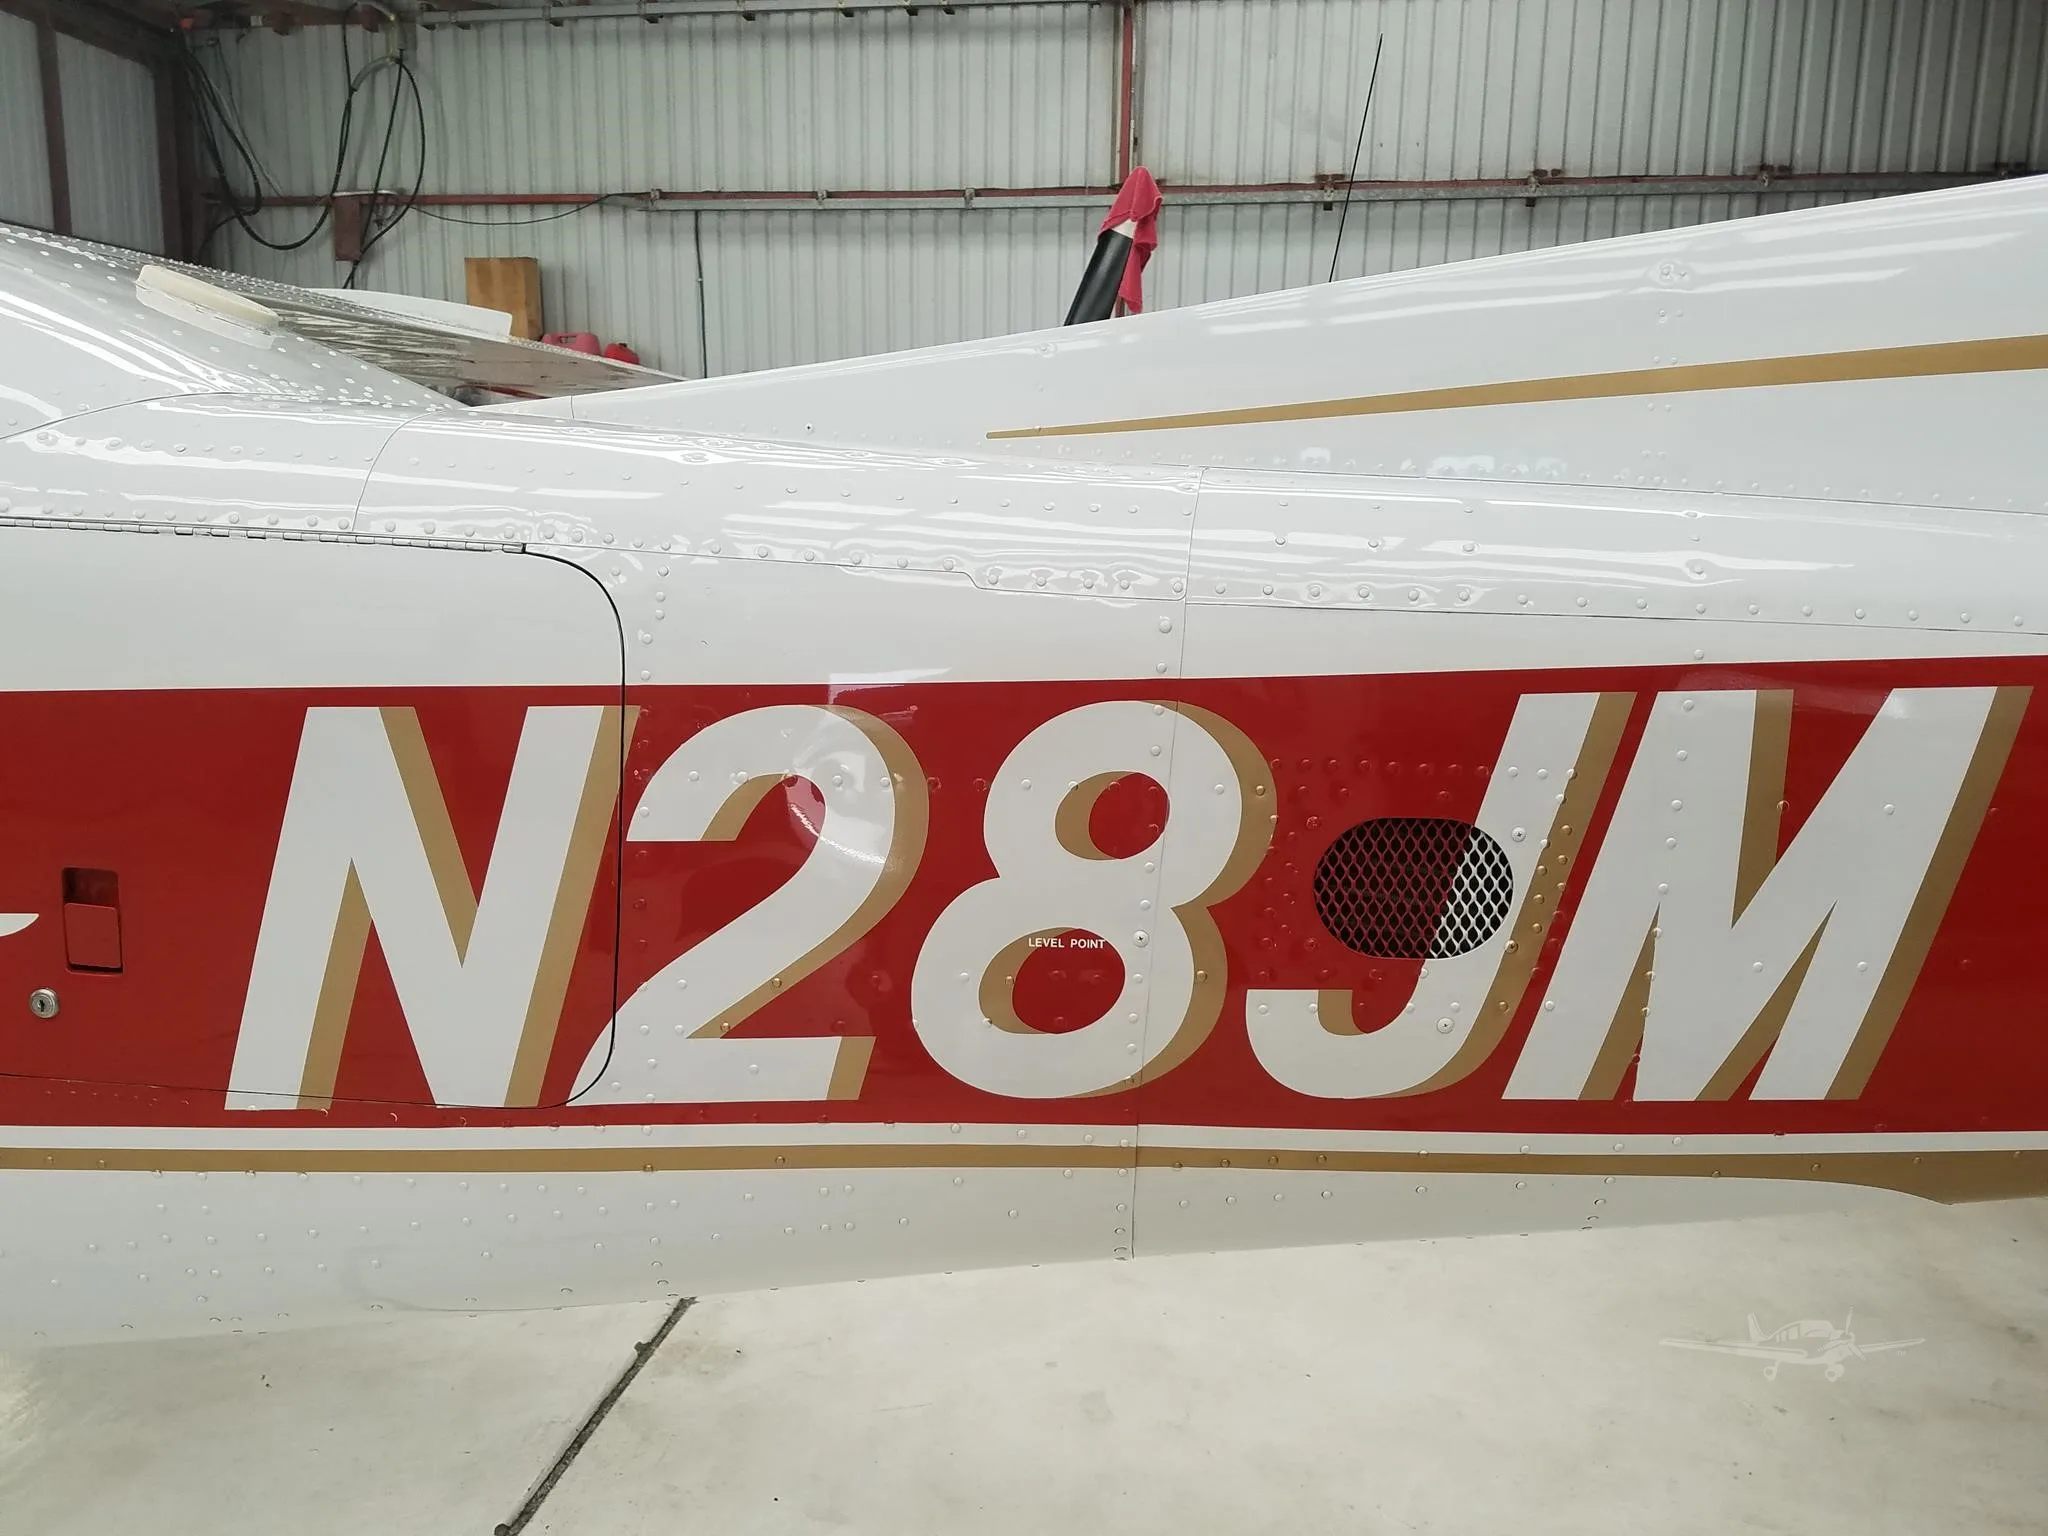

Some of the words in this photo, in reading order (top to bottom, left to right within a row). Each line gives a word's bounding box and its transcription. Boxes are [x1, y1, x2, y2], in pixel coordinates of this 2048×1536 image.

[224, 686, 2033, 1112] N28JM
[1028, 937, 1065, 948] LEVEL
[1070, 938, 1106, 949] POINT
